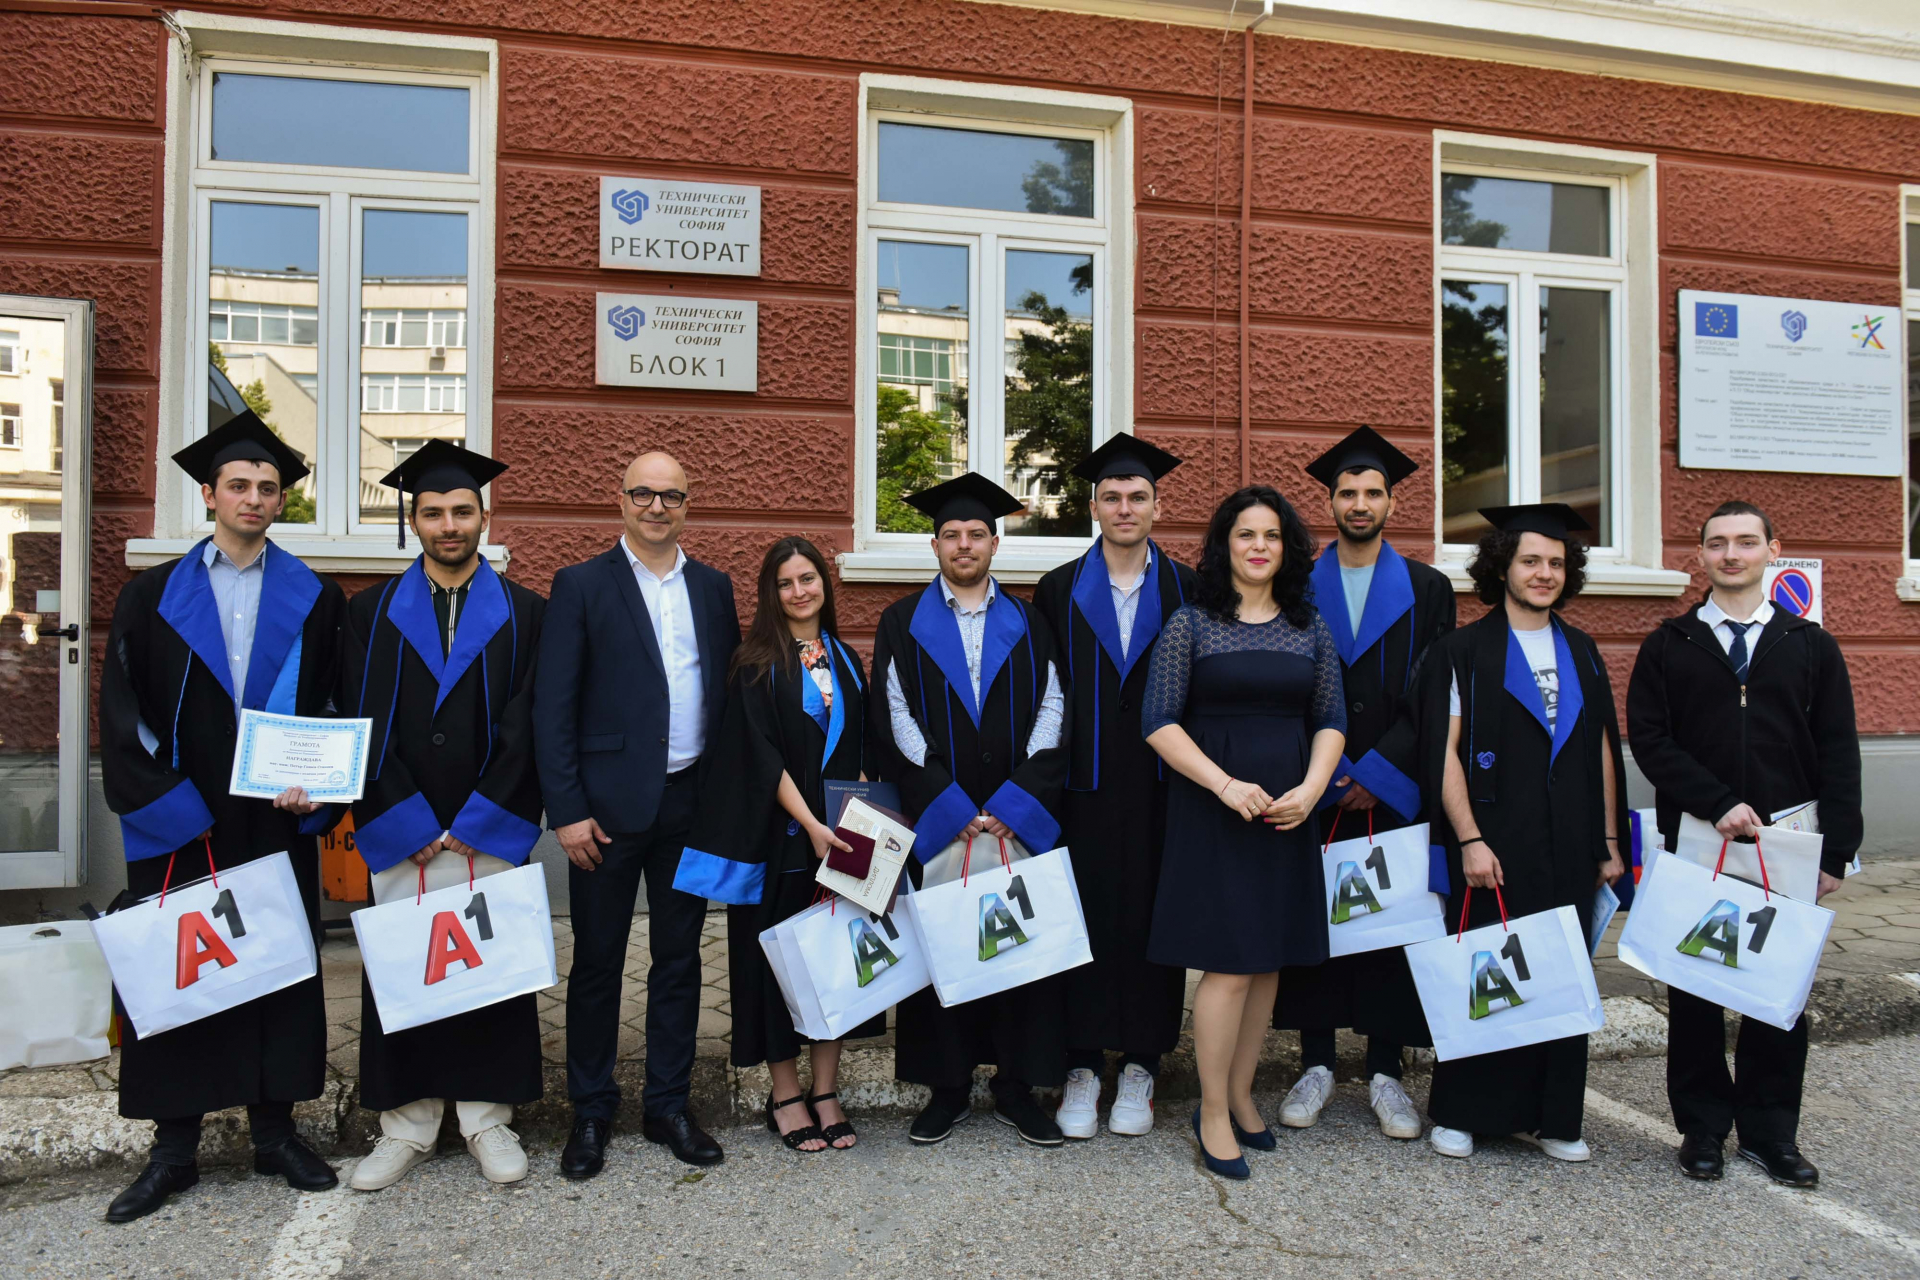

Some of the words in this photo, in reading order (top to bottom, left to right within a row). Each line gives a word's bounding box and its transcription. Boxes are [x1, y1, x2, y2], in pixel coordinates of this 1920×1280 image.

[658, 190, 747, 205] ТЕХНИЧЕСКИ
[655, 204, 750, 219] УНИВЕРСИТЕТ
[679, 219, 726, 231] СОФИЯ
[611, 236, 750, 263] РЕКТОРАТ
[654, 306, 743, 320] ТЕХНИЧЕСКИ
[651, 320, 746, 334] УНИВЕРСИТЕТ
[675, 335, 722, 346] СОФИЯ
[629, 354, 708, 377] БЛОК
[716, 358, 725, 377] 1
[290, 740, 320, 749] ГРАМОТА
[1330, 845, 1392, 925] A1
[978, 874, 1035, 961] A1
[176, 888, 247, 990] A1
[423, 891, 494, 986] A1
[1676, 899, 1777, 968] A1
[848, 911, 900, 988] A1
[1469, 932, 1531, 1021] A1
